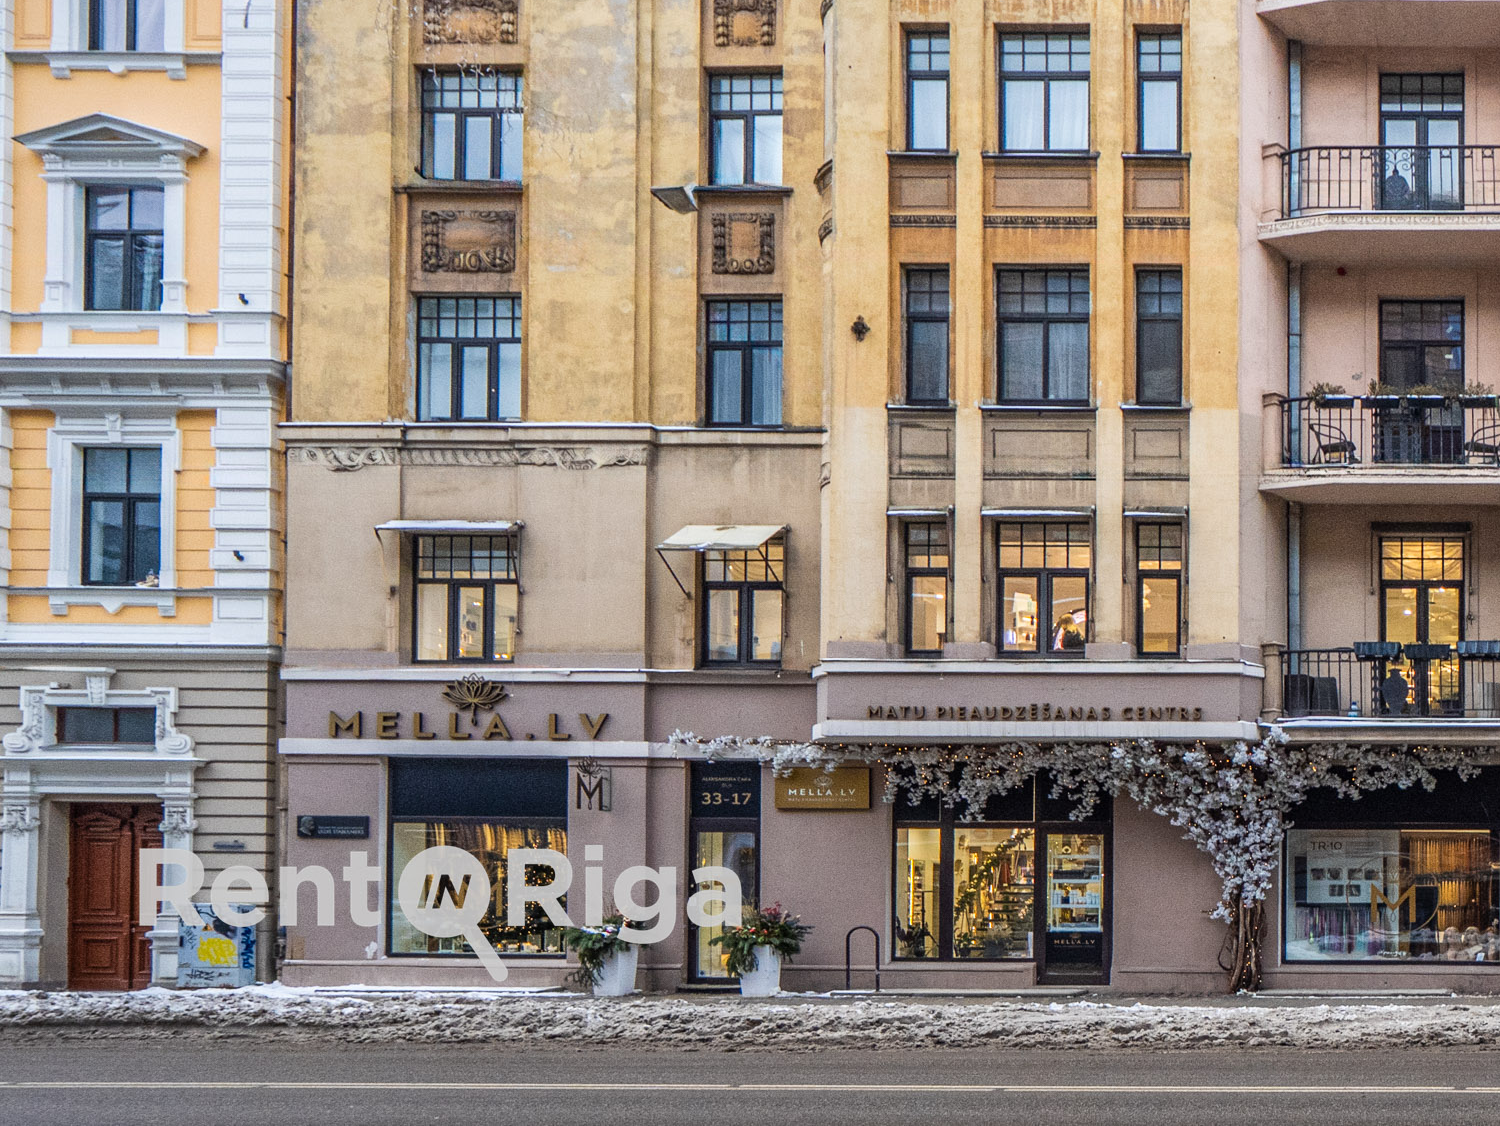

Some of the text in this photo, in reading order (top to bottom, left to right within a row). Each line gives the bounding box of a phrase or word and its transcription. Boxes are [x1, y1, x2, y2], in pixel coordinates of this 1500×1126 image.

[866, 703, 1203, 721] MATU PIEAUDZĒŠANAS CENTRS
[328, 710, 609, 741] MELLA.LV
[701, 792, 752, 805] 33-17
[788, 788, 856, 796] MELLA.LV
